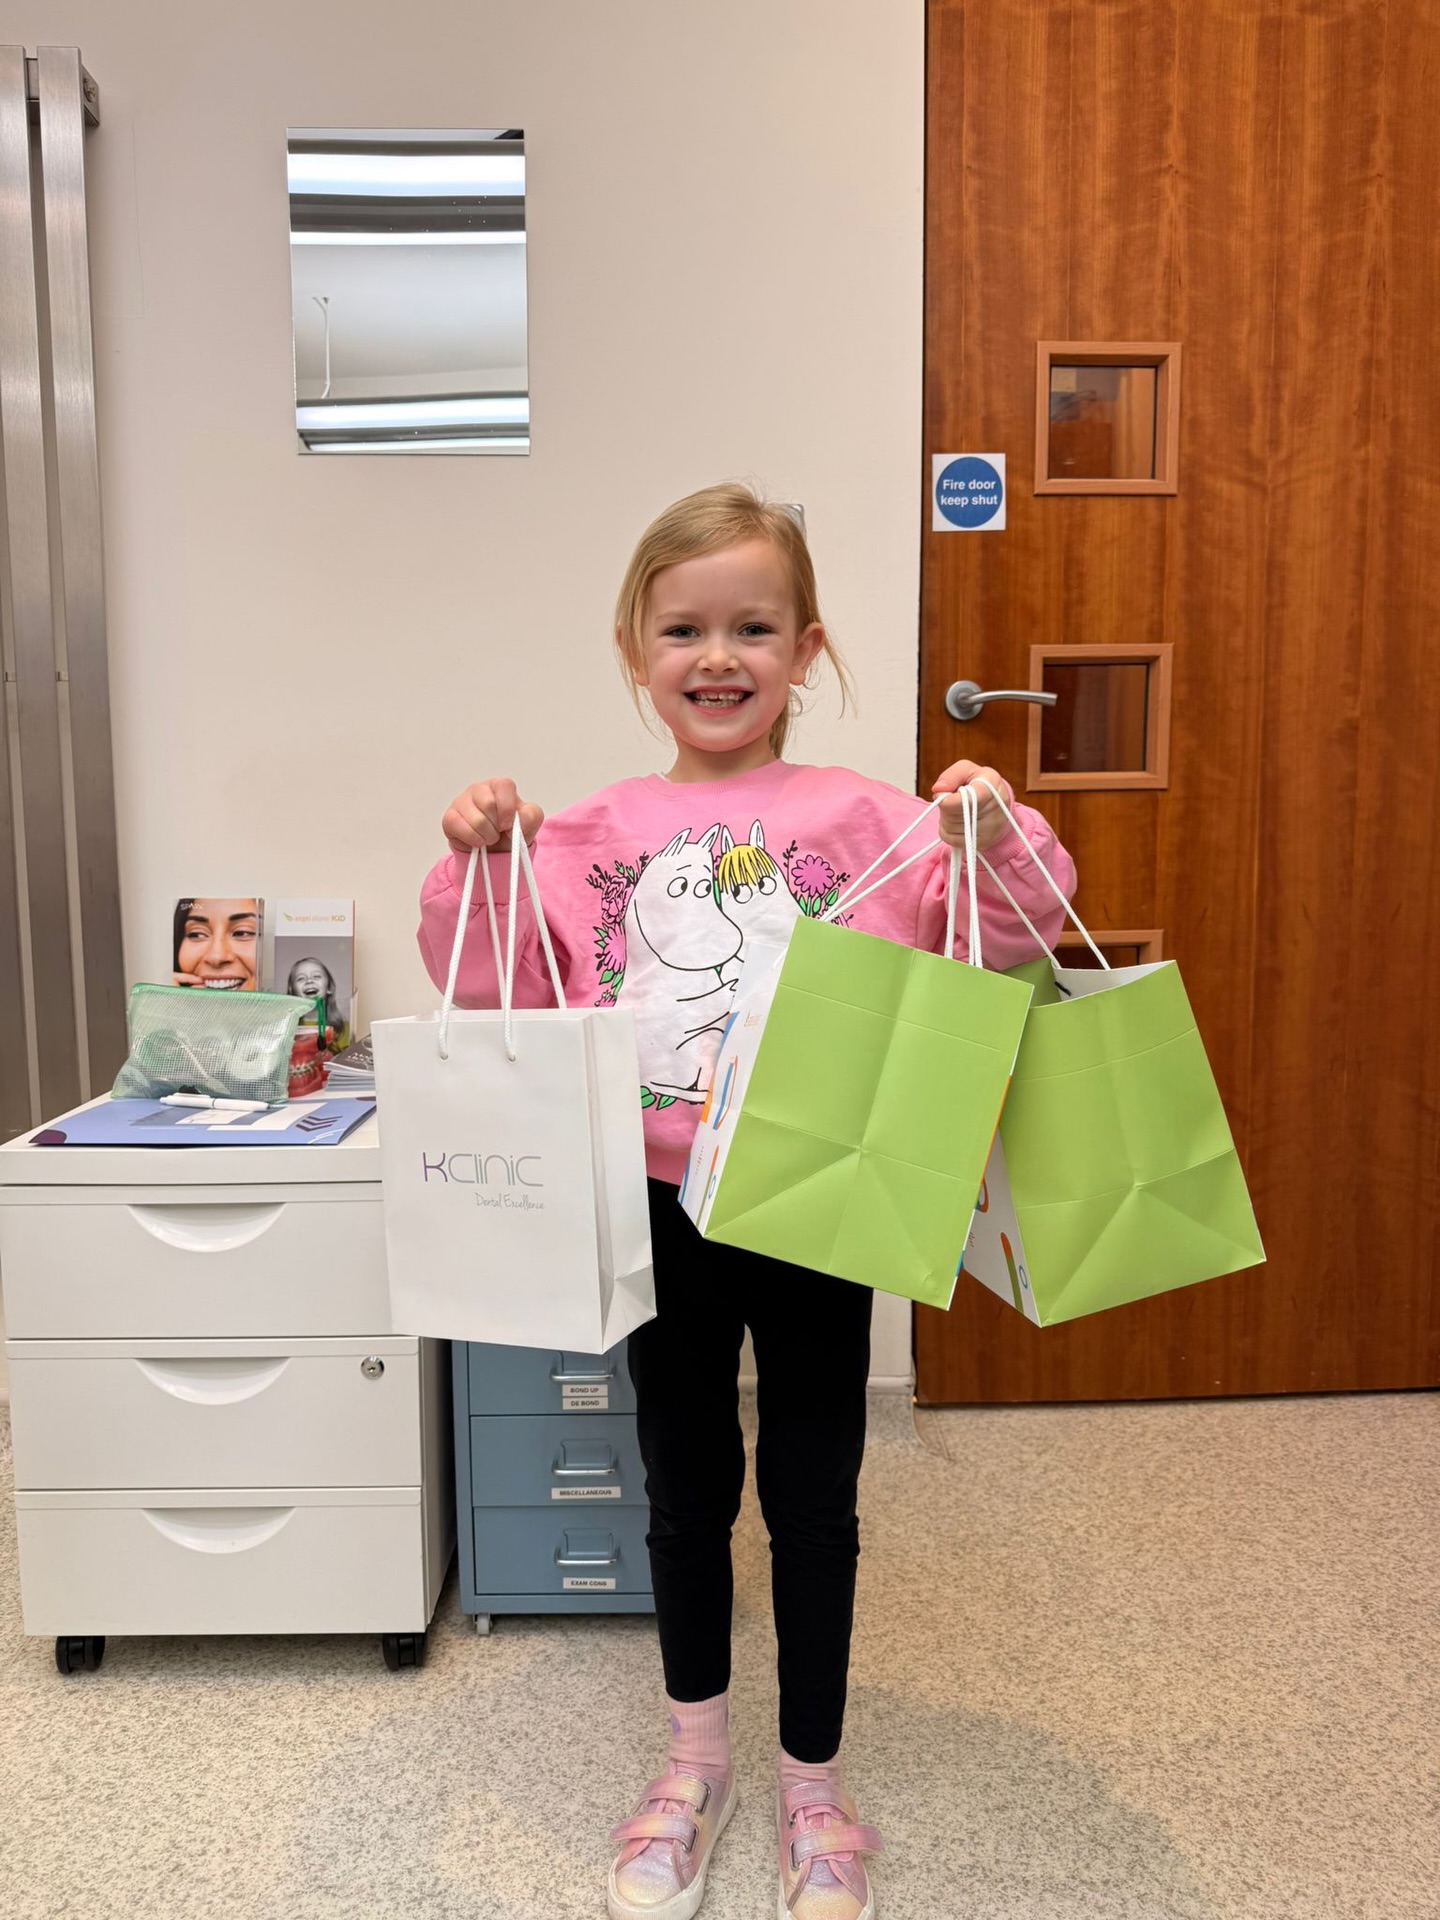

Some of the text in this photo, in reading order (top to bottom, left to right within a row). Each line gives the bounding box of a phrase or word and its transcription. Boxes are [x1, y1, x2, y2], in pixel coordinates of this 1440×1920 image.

[942, 479, 996, 490] Fire door
[940, 494, 998, 508] keep shut
[474, 1192, 545, 1211] Dental Excellence
